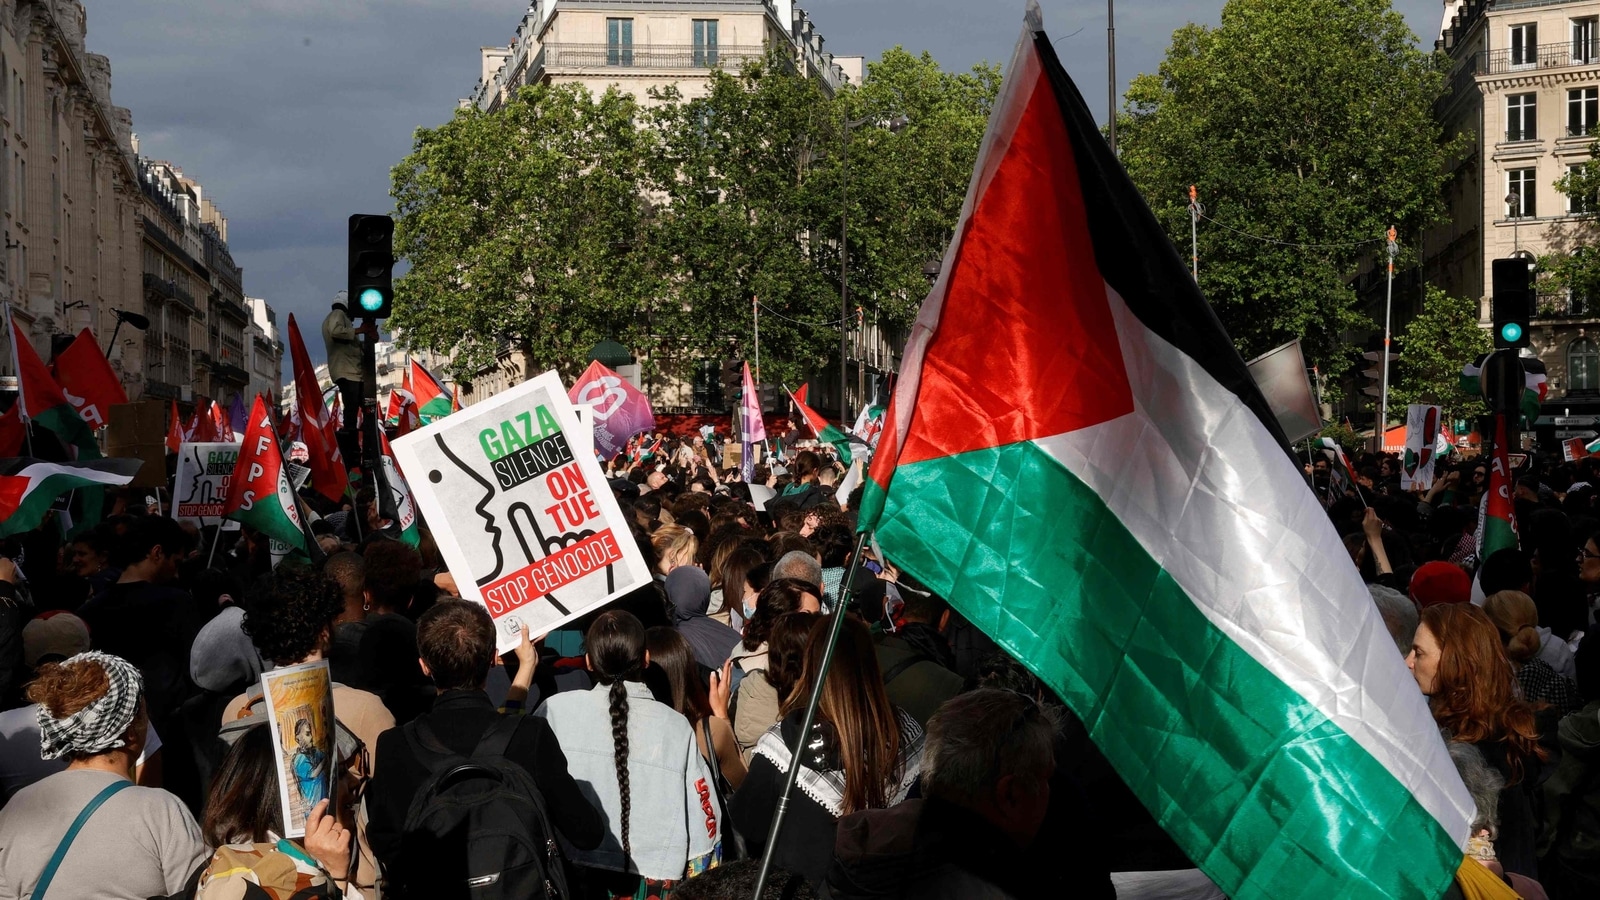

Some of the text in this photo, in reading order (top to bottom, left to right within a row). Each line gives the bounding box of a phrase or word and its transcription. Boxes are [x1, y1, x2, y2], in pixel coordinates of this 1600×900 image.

[479, 404, 561, 461] GAZA
[208, 451, 238, 463] GAZA
[496, 435, 572, 490] SILENCE
[216, 487, 227, 498] TU
[546, 462, 587, 500] ON
[179, 506, 197, 516] STOP
[544, 490, 600, 533] TUE
[486, 534, 618, 615] STOP GÉNOCIDE
